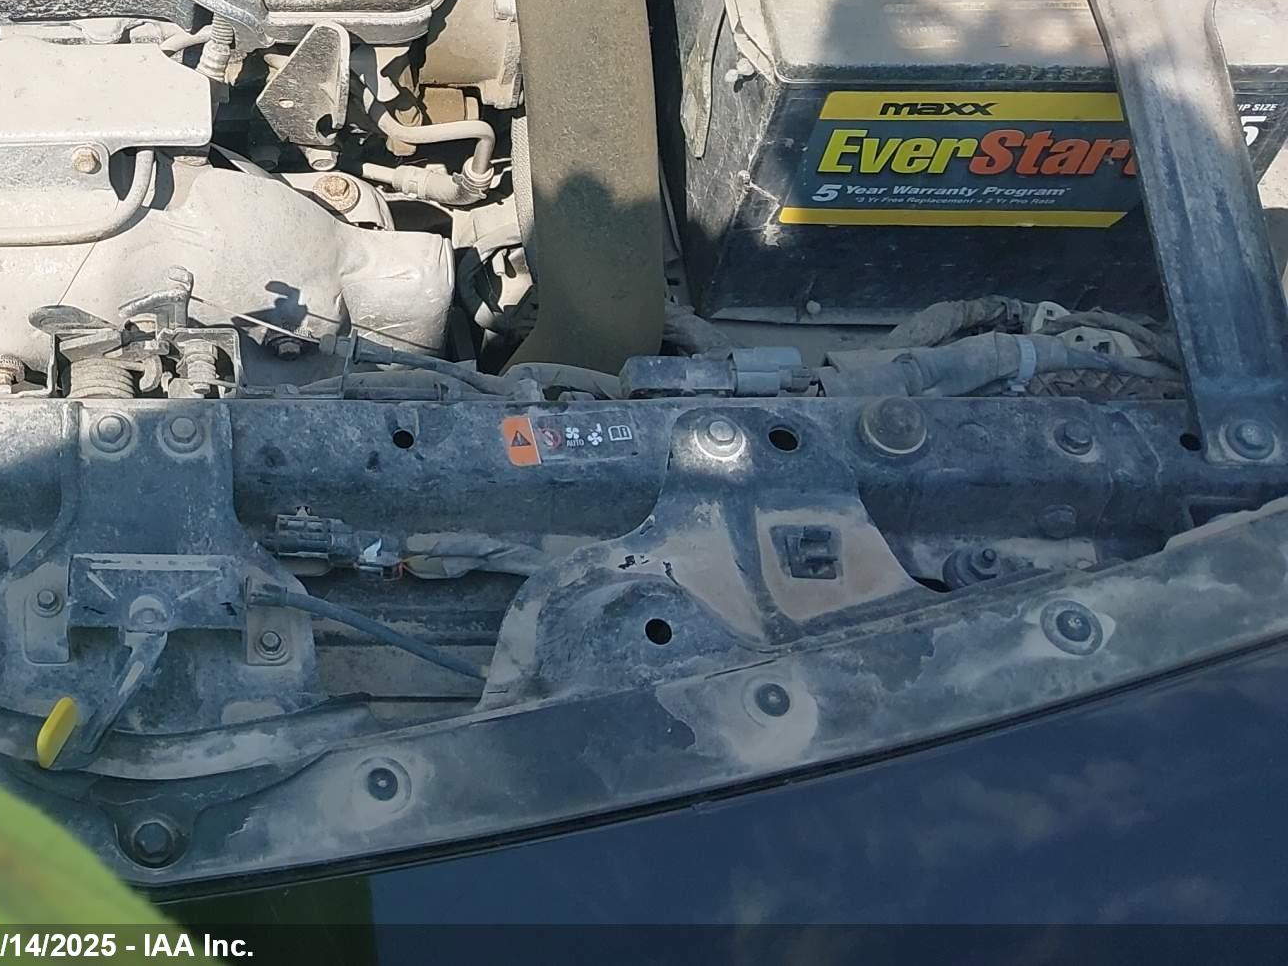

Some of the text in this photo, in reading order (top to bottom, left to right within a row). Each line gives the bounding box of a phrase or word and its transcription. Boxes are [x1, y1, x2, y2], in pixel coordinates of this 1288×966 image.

[879, 102, 1000, 116] maxx
[1251, 103, 1279, 112] SIZE
[812, 184, 843, 202] 5
[845, 185, 888, 195] Year
[892, 185, 979, 198] Warranty
[908, 197, 976, 205] Replacement
[566, 438, 585, 448] AUTO
